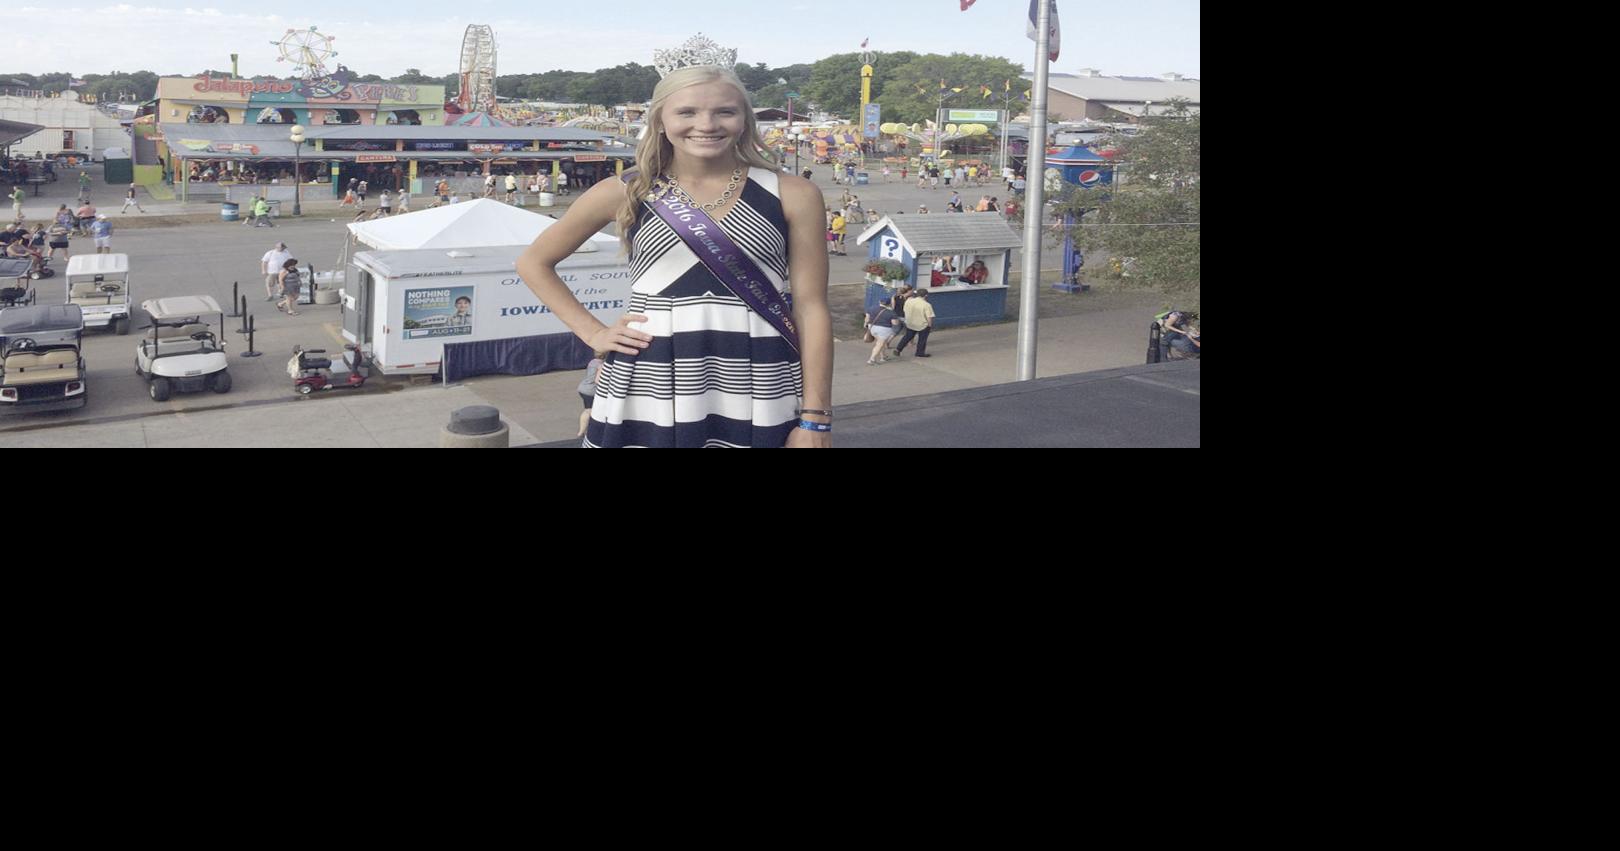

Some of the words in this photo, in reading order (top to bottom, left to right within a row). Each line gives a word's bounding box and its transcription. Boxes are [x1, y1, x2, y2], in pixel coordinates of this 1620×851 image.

[663, 195, 695, 223] 2016
[688, 222, 721, 255] Iowa
[718, 254, 747, 282] State
[745, 280, 768, 305] Fair
[408, 289, 450, 299] NOTHING
[584, 287, 607, 295] the
[500, 305, 551, 317] IOWA
